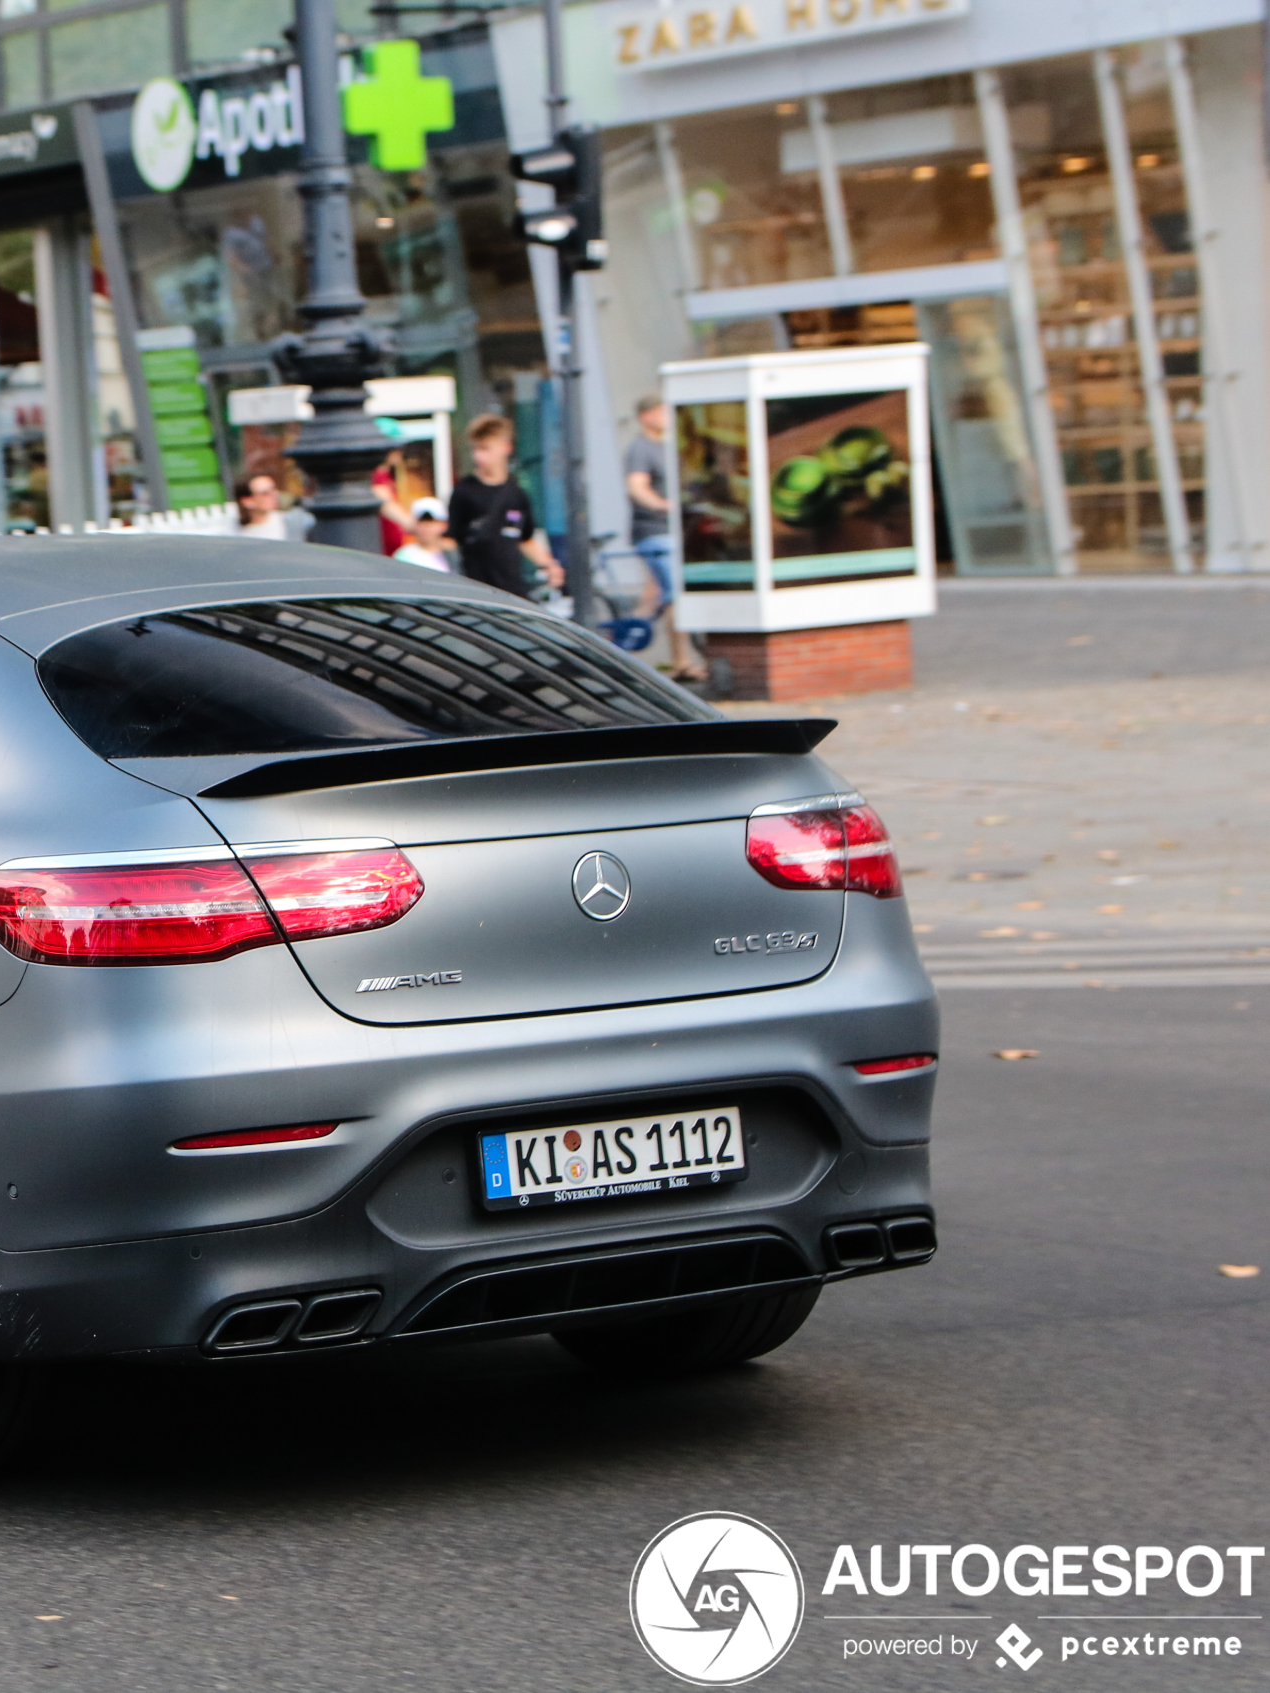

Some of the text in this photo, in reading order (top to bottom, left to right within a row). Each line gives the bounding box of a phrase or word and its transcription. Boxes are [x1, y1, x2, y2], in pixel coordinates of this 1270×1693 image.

[615, 4, 756, 63] ZARA
[714, 934, 762, 954] GLC
[515, 1116, 735, 1188] KI AS 1112
[492, 1172, 503, 1188] D
[608, 1180, 662, 1197] AUTOMOBILE
[668, 1177, 690, 1189] KIEL
